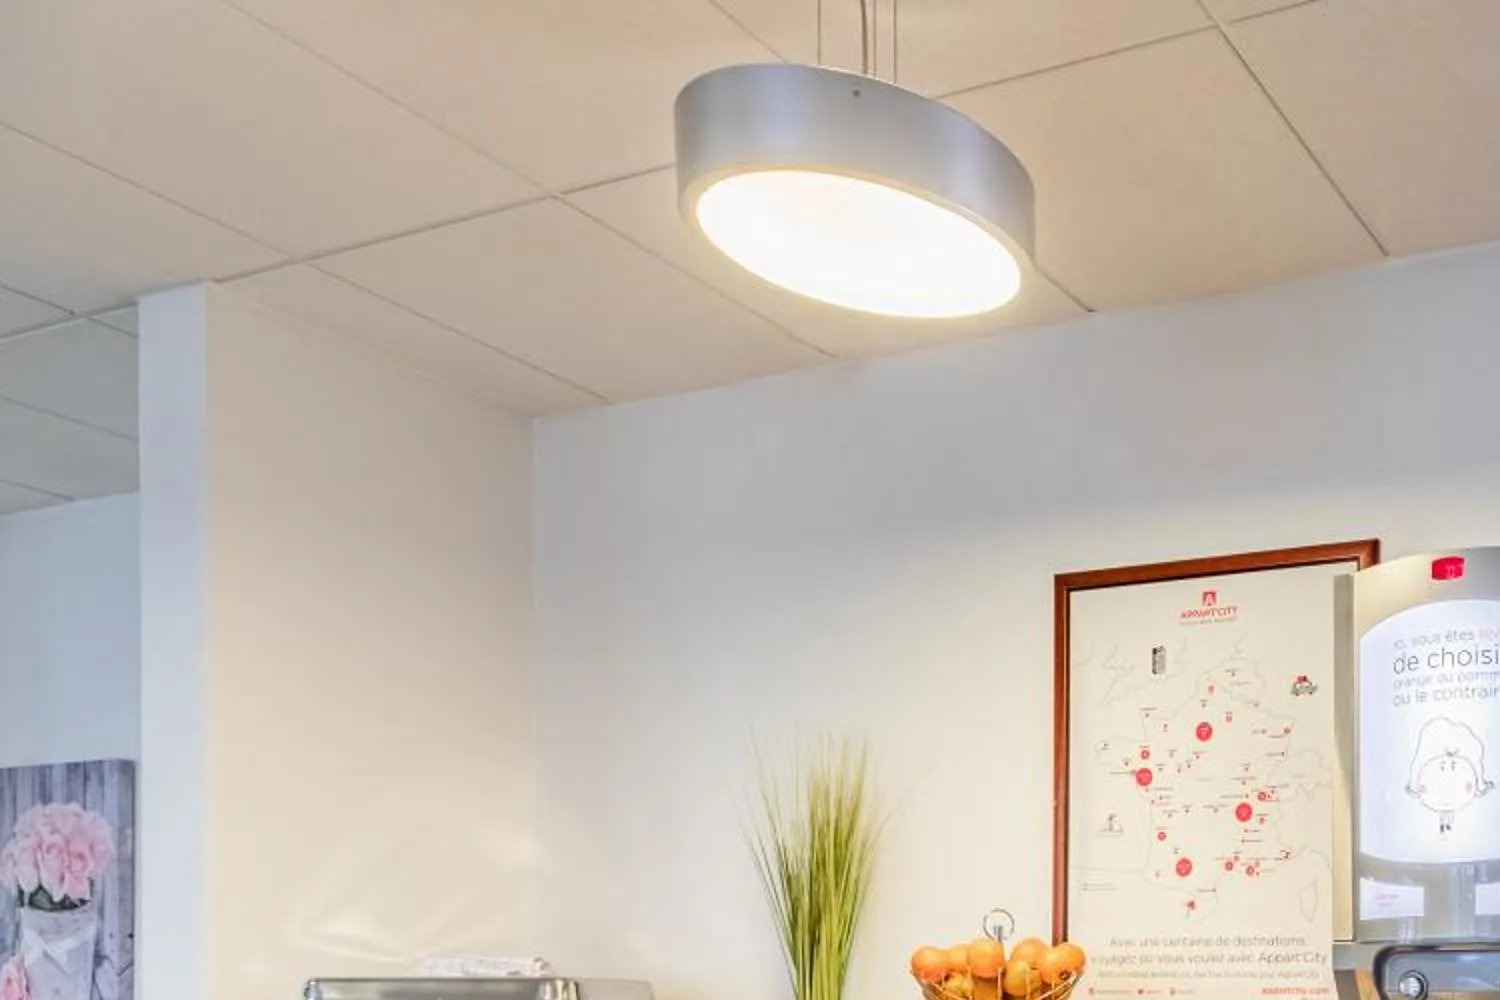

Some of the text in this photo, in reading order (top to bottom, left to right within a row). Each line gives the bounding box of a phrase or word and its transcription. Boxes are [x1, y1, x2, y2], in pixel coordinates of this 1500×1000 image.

[1393, 651, 1420, 675] de
[1392, 691, 1412, 707] ou
[1415, 687, 1428, 703] le
